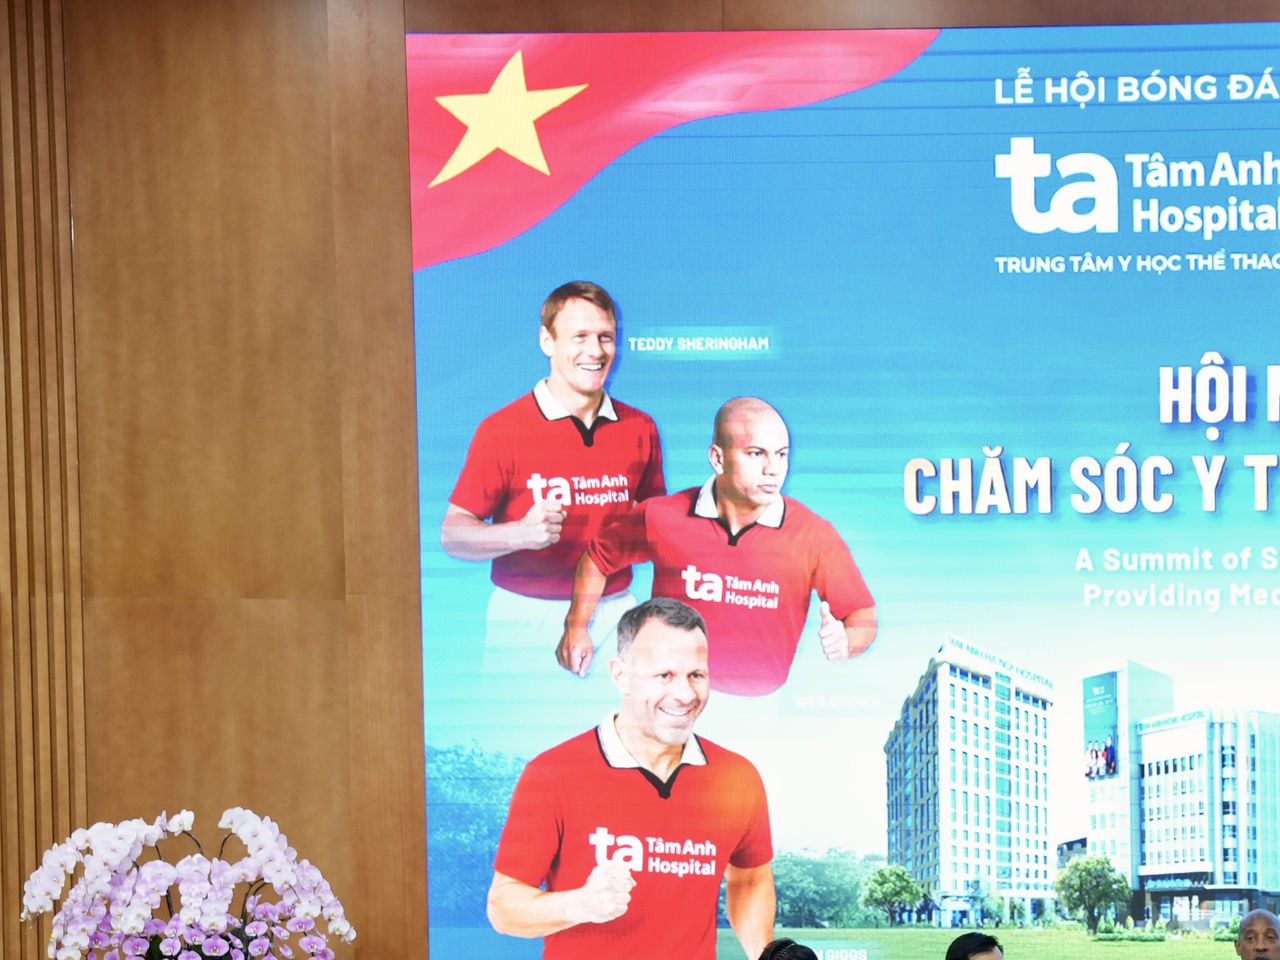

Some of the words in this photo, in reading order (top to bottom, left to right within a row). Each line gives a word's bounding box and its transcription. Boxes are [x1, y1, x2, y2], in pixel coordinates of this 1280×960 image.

[995, 67, 1034, 104] LỄ
[1045, 71, 1105, 109] HỘI
[1118, 69, 1217, 103] BÓNG
[1227, 67, 1279, 99] ĐÁ
[1125, 152, 1205, 188] Tâm
[995, 137, 1119, 234] ta
[995, 255, 1066, 274] TRUNG
[1069, 252, 1114, 273] TÂM
[1118, 255, 1133, 271] Y
[1136, 254, 1182, 276] HỌC
[1186, 247, 1226, 271] THỂ
[628, 337, 674, 351] TEDDY
[677, 336, 770, 351] SHERINGHAM
[1159, 351, 1247, 442] HỘI
[526, 473, 572, 506] ta
[571, 476, 600, 489] Tâm
[601, 474, 628, 488] Anh
[903, 445, 1052, 516] CHĂM
[1069, 442, 1175, 514] SÓC
[1192, 455, 1226, 512] Y
[575, 489, 629, 506] Hospital
[1074, 549, 1095, 572] A
[1102, 546, 1213, 572] Summit
[1221, 546, 1253, 571] of
[681, 564, 723, 602] ta
[725, 575, 752, 591] Tâm
[753, 578, 779, 594] Anh
[1083, 582, 1221, 613] Providing
[725, 590, 779, 609] Hospital
[589, 827, 644, 872] ta
[645, 837, 681, 854] Tâm
[682, 840, 716, 856] Anh
[648, 857, 716, 878] Hospital
